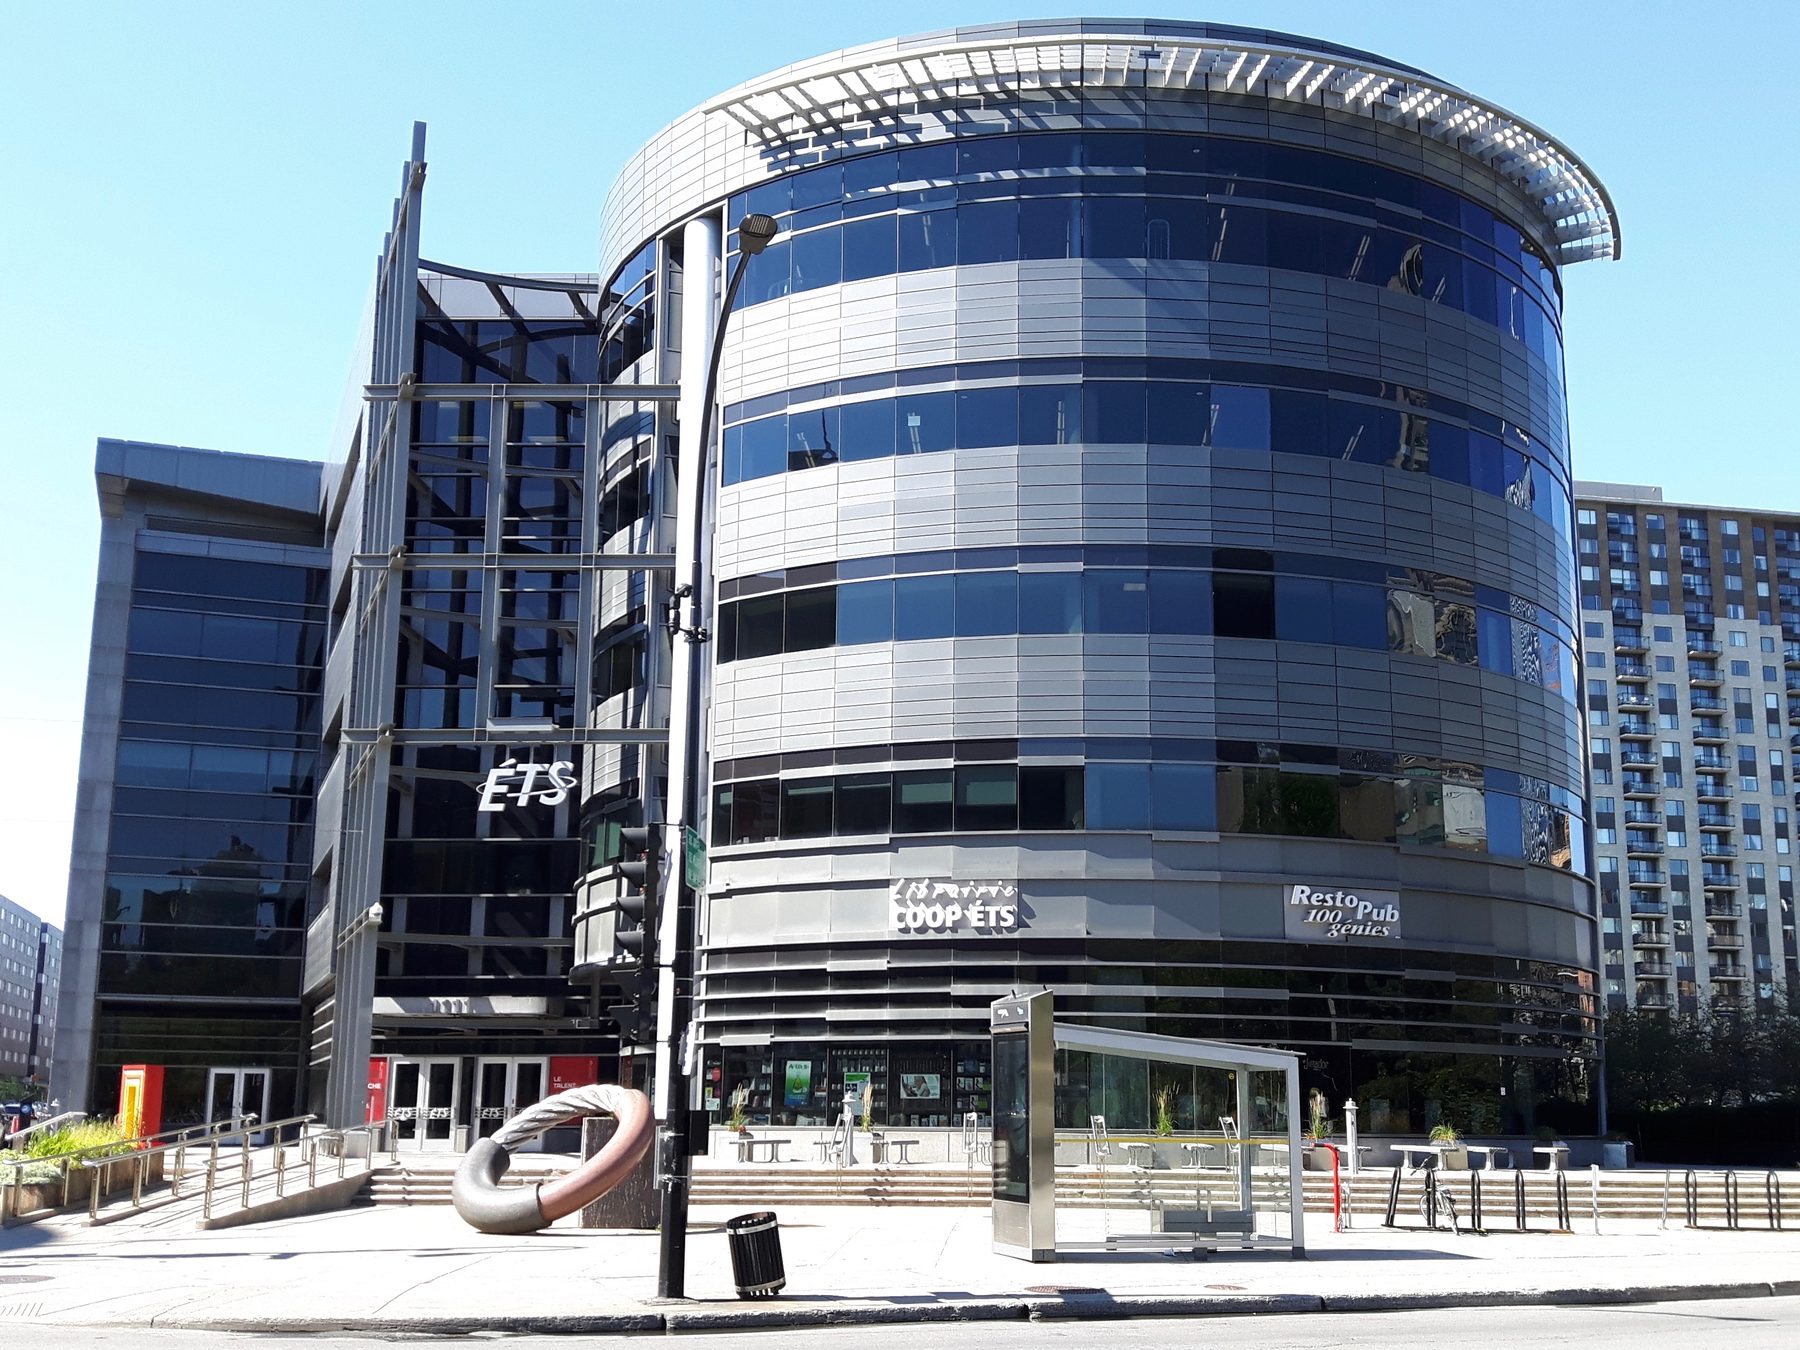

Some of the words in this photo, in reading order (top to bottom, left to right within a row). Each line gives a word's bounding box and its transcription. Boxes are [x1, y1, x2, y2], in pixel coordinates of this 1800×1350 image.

[477, 758, 576, 811] ÉTS
[892, 878, 1017, 899] Librairie
[895, 905, 962, 929] COOP
[970, 900, 1015, 928] ÉTS
[1304, 908, 1343, 923] 100
[1327, 920, 1391, 938] génies
